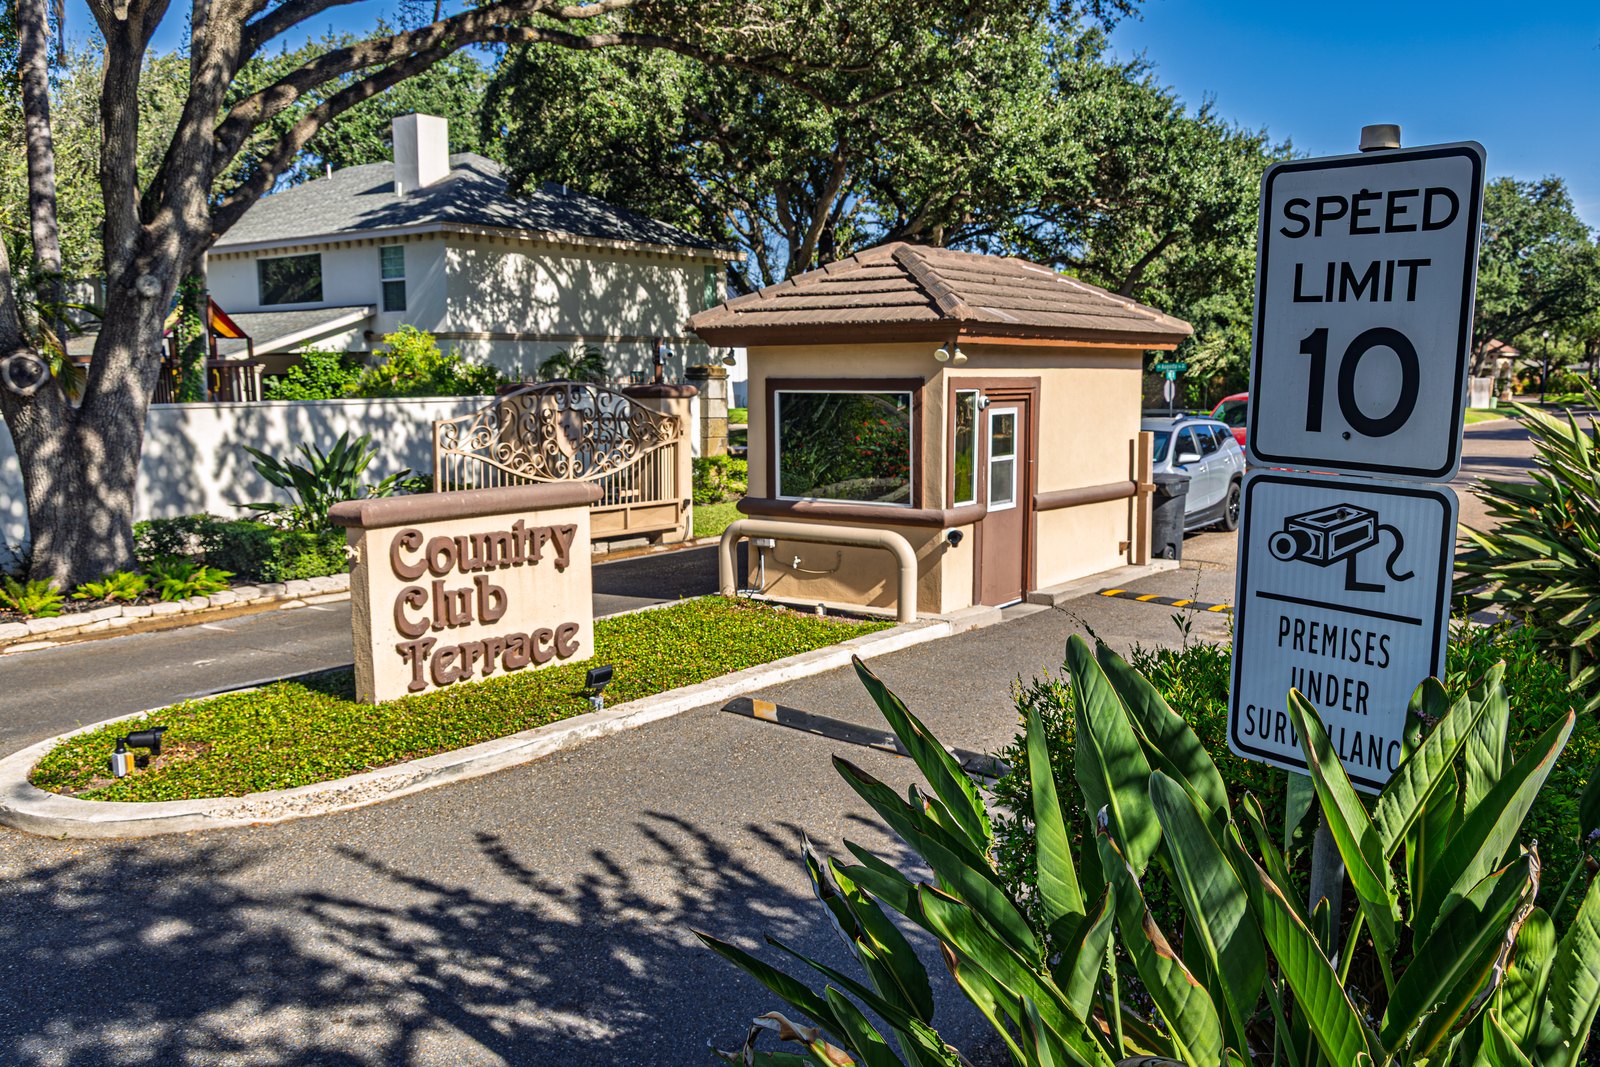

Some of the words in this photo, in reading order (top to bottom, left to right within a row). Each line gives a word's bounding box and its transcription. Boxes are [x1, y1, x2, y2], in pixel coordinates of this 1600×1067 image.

[1280, 187, 1459, 238] SPEED
[1293, 258, 1431, 302] LIMIT
[1299, 327, 1420, 437] 10
[390, 519, 578, 581] Country
[394, 574, 508, 638] Club
[395, 622, 580, 692] Terrace
[1278, 615, 1390, 668] PREMISES
[1291, 666, 1369, 715] UNDER
